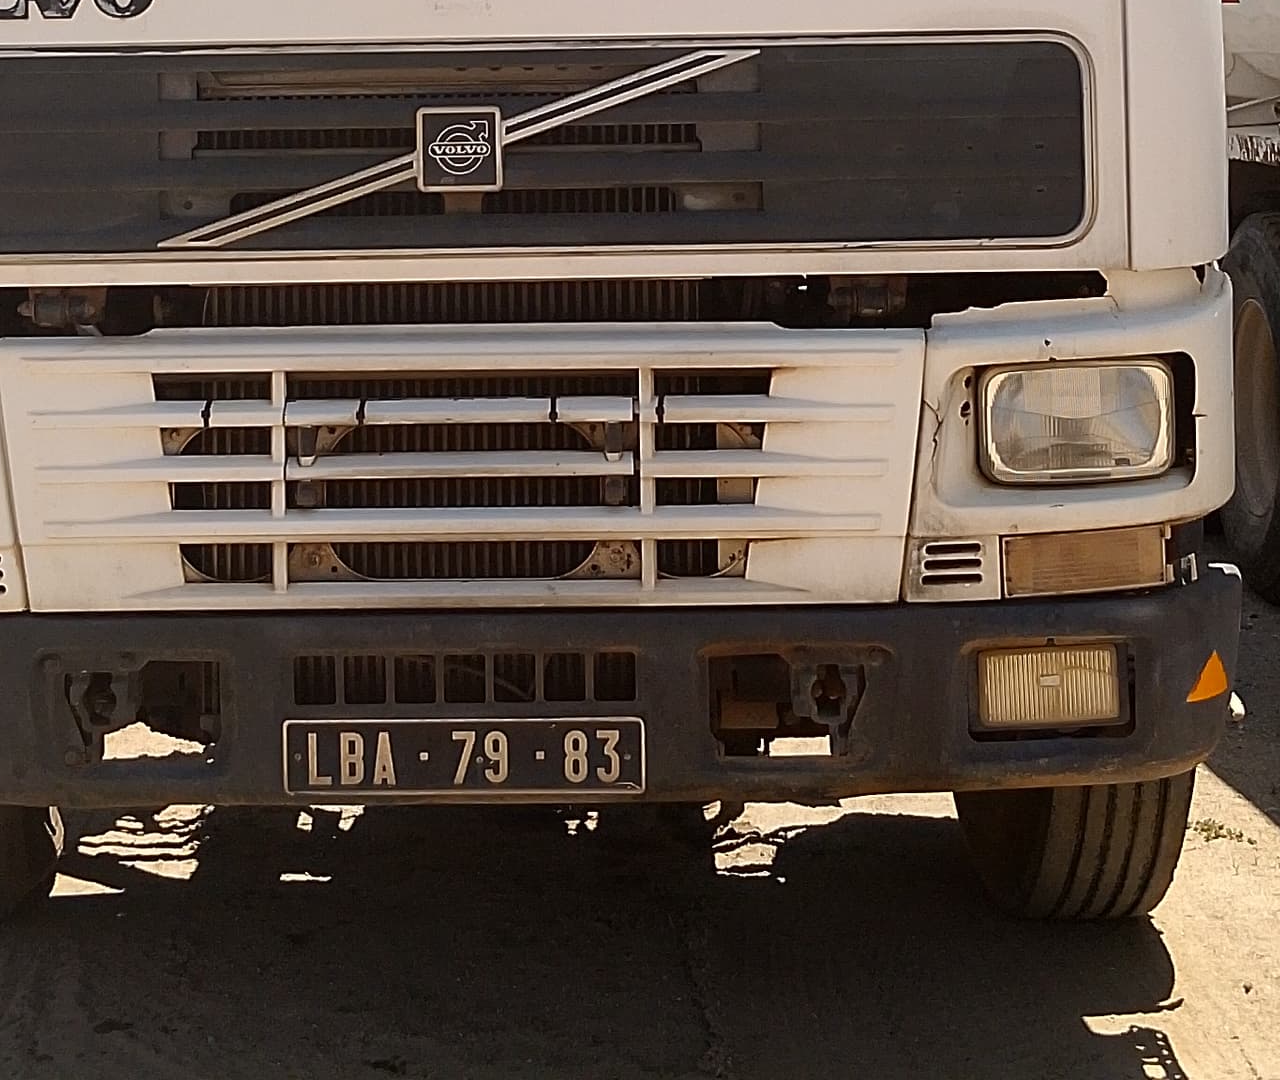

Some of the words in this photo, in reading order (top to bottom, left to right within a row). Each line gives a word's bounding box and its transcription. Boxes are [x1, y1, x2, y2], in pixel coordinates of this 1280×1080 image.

[432, 145, 487, 155] VOLVO
[307, 730, 397, 786] LBA
[451, 730, 508, 785] 79
[563, 728, 620, 784] 83
